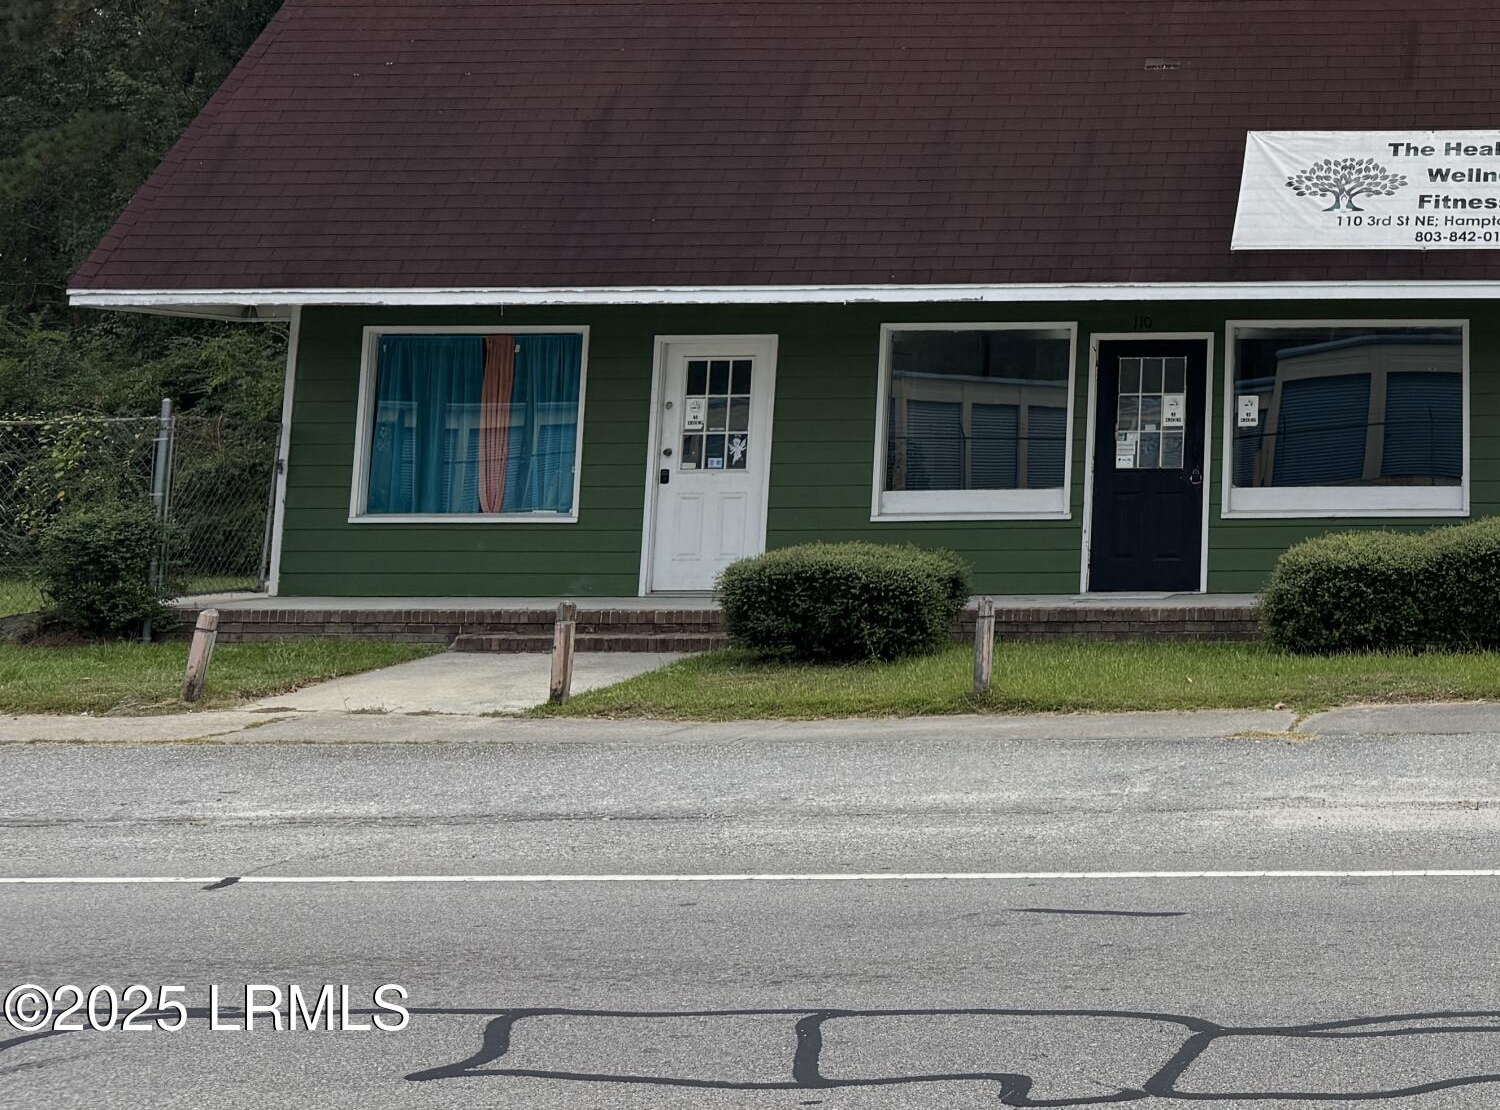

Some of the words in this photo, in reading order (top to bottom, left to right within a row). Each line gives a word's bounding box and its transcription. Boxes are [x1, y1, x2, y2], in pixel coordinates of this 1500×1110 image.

[1388, 142, 1435, 157] The
[1336, 215, 1362, 227] 110
[1367, 215, 1391, 226] 3rd
[1397, 215, 1410, 226] St
[1415, 216, 1439, 227] NE;
[1134, 315, 1153, 328] 110
